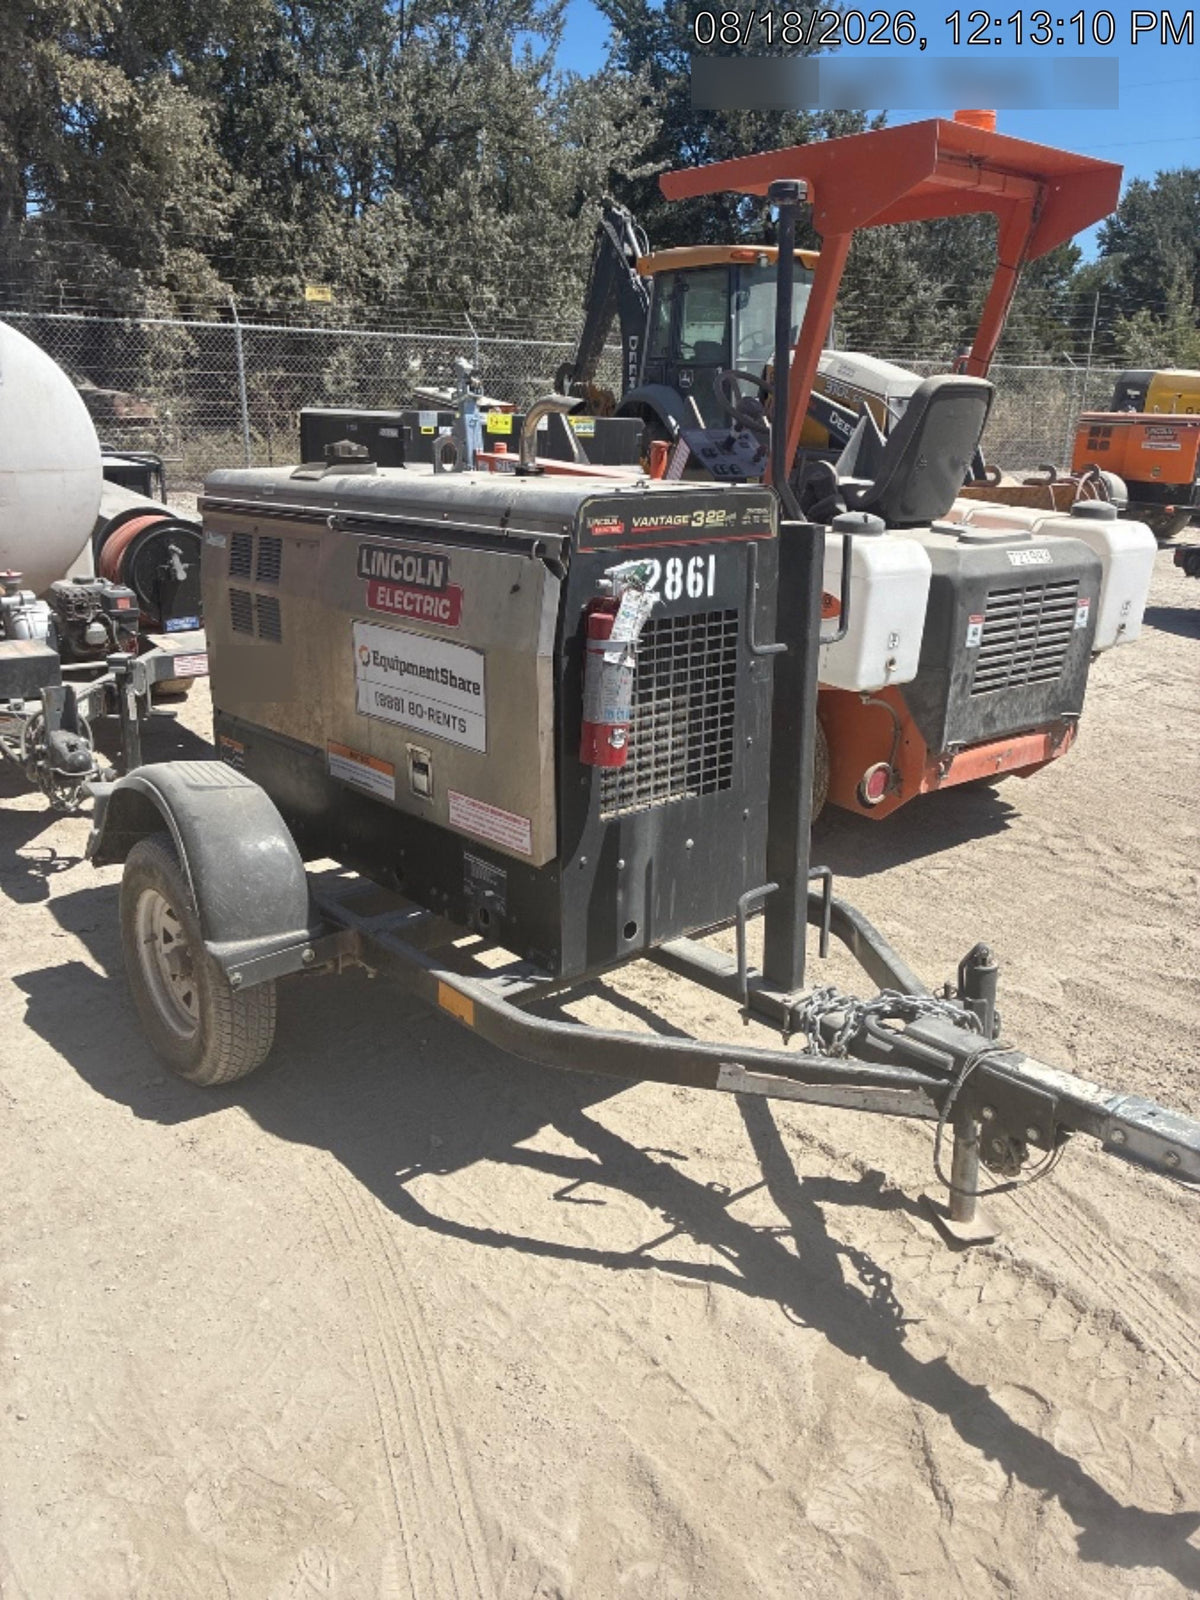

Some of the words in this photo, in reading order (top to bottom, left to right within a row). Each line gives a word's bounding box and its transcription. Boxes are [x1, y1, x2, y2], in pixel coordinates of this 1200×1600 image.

[629, 335, 639, 389] DEER
[830, 411, 856, 437] DEE
[632, 515, 690, 527] VANTAGE
[361, 548, 444, 588] LINCOLN
[376, 586, 451, 620] ELECTRIC
[372, 650, 481, 695] EquipmentShare
